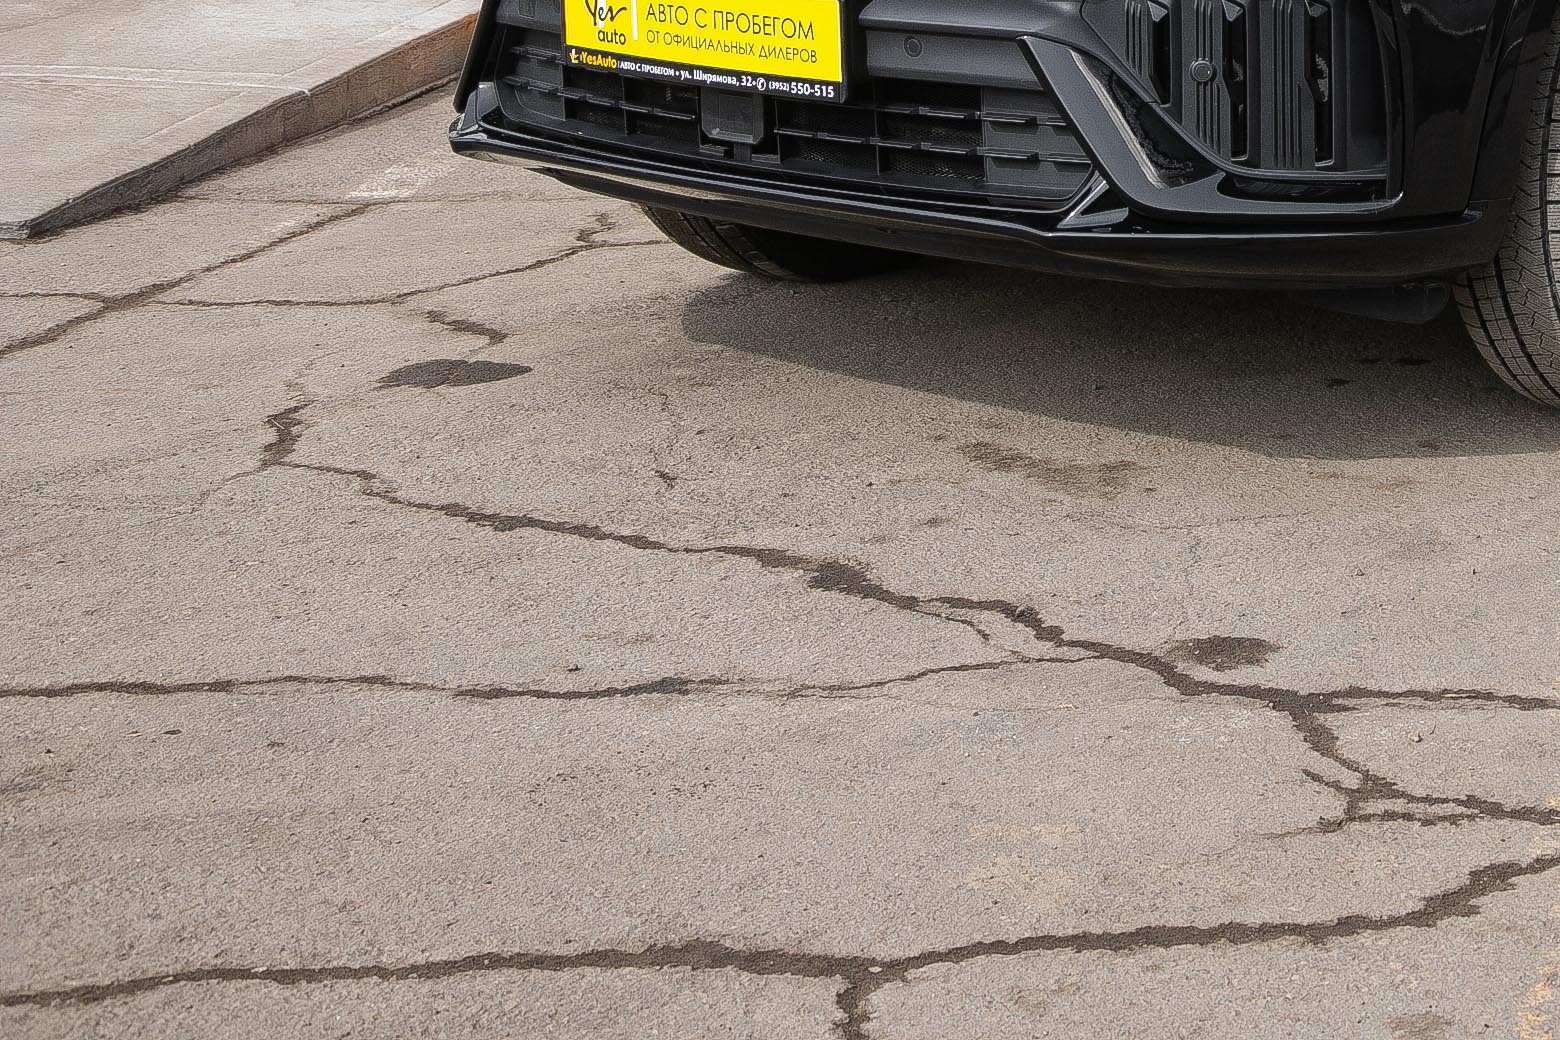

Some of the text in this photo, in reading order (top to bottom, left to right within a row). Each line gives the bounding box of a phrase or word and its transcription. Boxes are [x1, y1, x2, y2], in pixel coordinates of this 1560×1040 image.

[597, 28, 627, 46] auto
[645, 3, 815, 41] АВТО С ПРОБЕГОМ
[646, 29, 818, 63] ОТ ОФИЦИАЛЬНЫХ ДИЛЕРОВ
[582, 51, 617, 69] YesAuto
[680, 70, 692, 81] ул.
[693, 70, 740, 86] Ширямова,
[740, 75, 752, 86] 32
[768, 81, 790, 92] (3952)
[791, 82, 835, 98] 550-515
